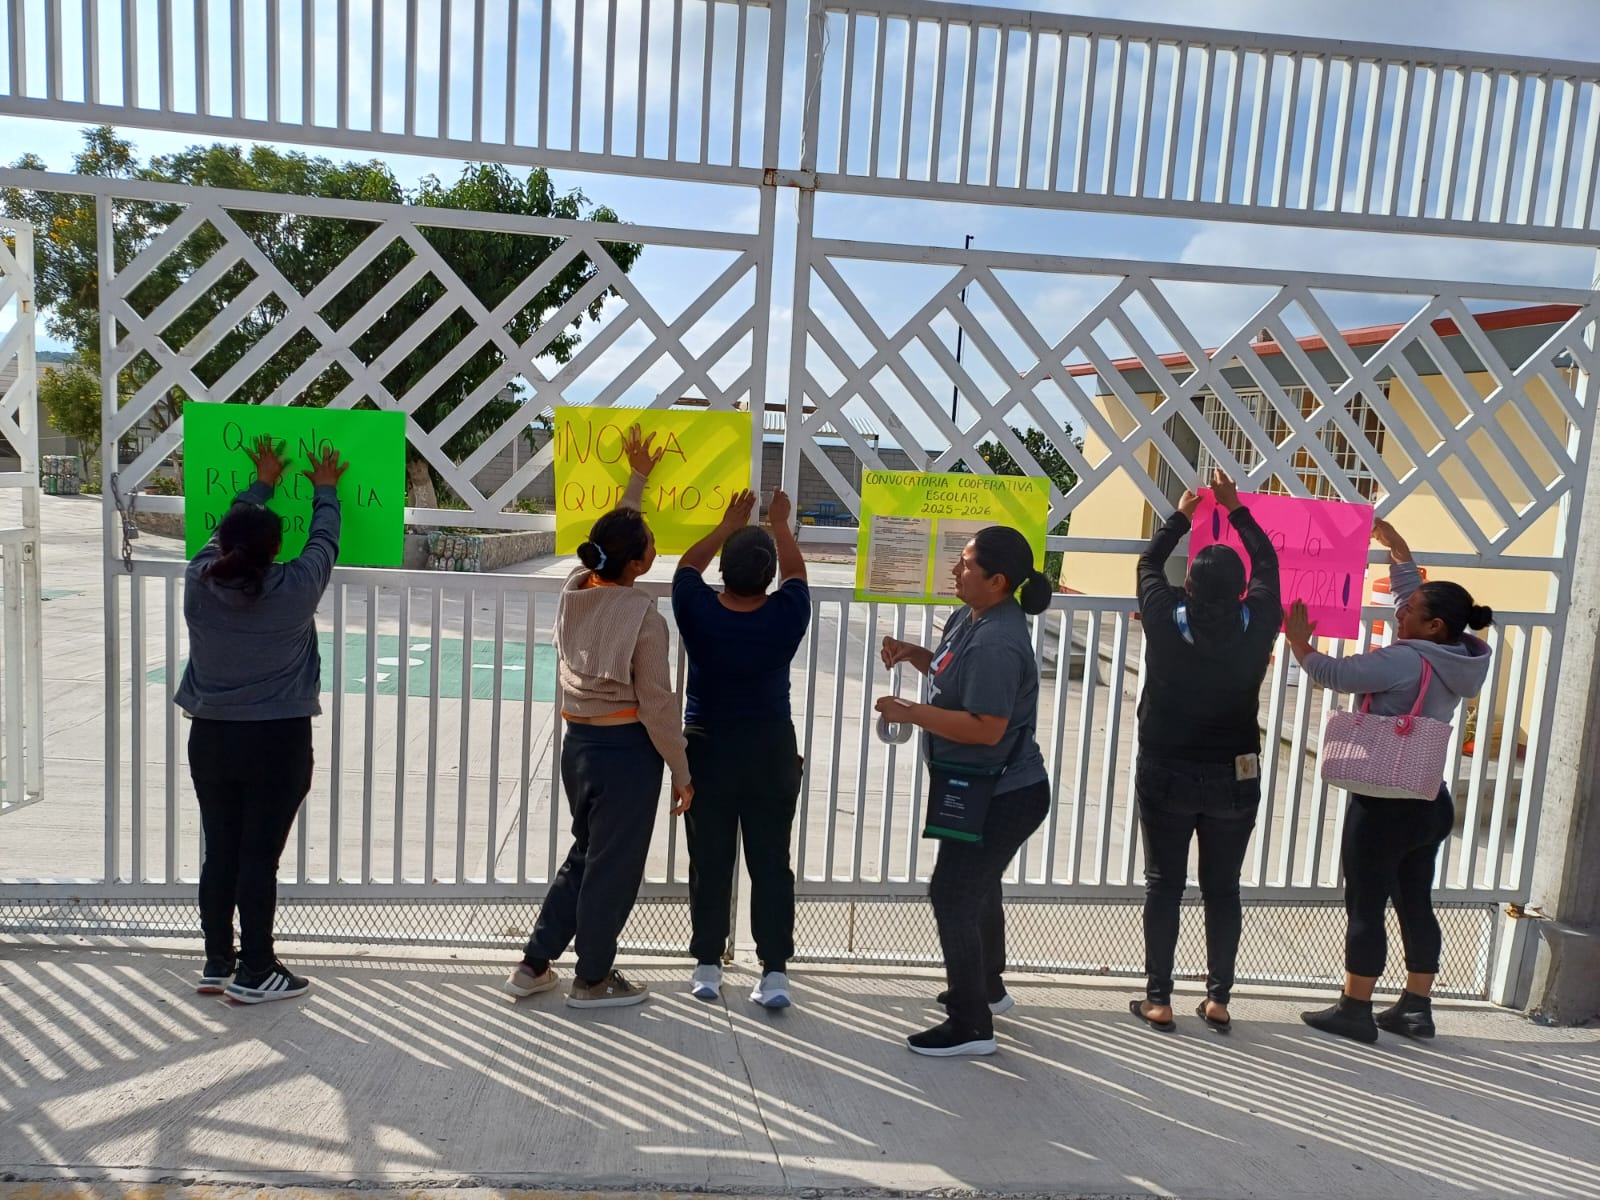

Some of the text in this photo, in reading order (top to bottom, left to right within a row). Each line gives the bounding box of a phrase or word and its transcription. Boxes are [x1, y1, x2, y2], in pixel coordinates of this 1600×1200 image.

[299, 427, 335, 460] NO
[865, 472, 1033, 493] CONVOCATORIA COOPERATIVA
[357, 484, 383, 508] LA
[926, 489, 978, 504] ESCOLAR
[920, 502, 992, 516] 2025-2026
[1302, 513, 1322, 558] la
